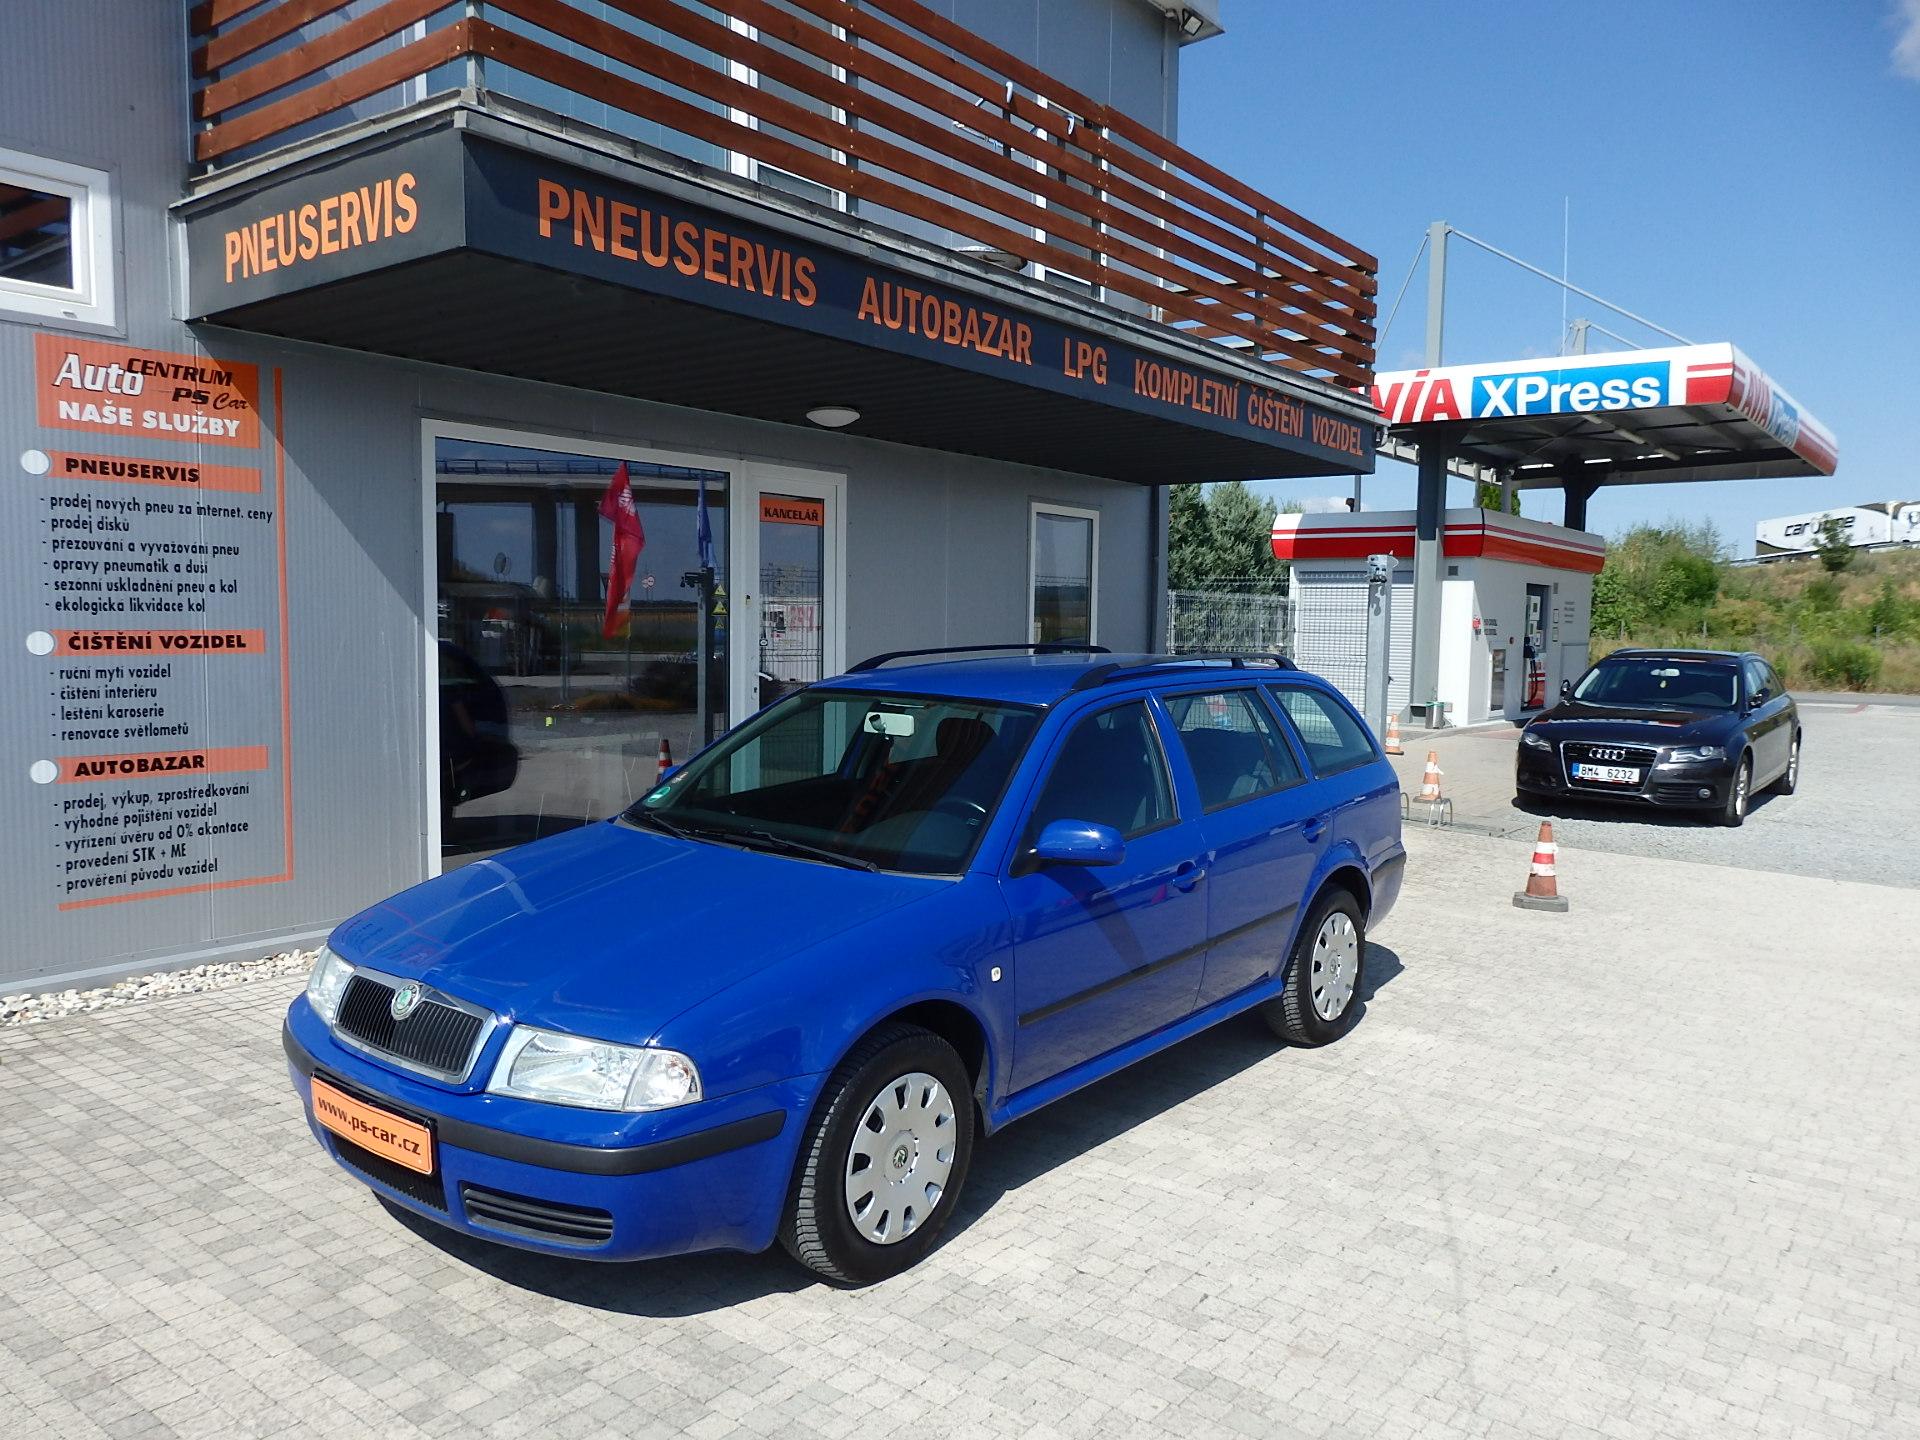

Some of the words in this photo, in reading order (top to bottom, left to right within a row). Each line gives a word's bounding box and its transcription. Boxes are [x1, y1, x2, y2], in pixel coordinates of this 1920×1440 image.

[225, 173, 418, 283] PNEUSERVIS
[538, 178, 817, 307] PNEUSERVIS
[858, 276, 1032, 367] AUTOBAZAR
[1064, 337, 1108, 385] LPG
[1134, 358, 1241, 420] KOMPLETNÍ
[1247, 385, 1305, 438] ČIŠTĚNÍ
[1312, 413, 1363, 456] VOZIDEL
[52, 352, 145, 396] Auto
[127, 358, 233, 386] CENTRUM
[172, 387, 211, 405] PS
[212, 392, 249, 410] Car
[1479, 375, 1663, 419] XPress
[58, 399, 133, 427] NAŠE
[142, 409, 240, 438] SLUŽBY
[65, 457, 200, 483] PNEUSERVIS
[50, 493, 91, 512] prodej
[96, 497, 141, 514] nových
[146, 502, 174, 515] pneu
[178, 504, 192, 515] za
[197, 501, 244, 518] internet.
[247, 510, 273, 523] ceny
[764, 507, 818, 521] KANCELÁŘ
[52, 514, 92, 534] prodej
[128, 542, 135, 552] a
[212, 545, 240, 558] pneu
[53, 560, 99, 574] opravy
[104, 558, 169, 575] pneumatik
[174, 563, 181, 573] a
[177, 582, 205, 596] pneu
[209, 584, 216, 593] a
[220, 579, 237, 593] kol
[130, 597, 183, 612] likvidace
[188, 598, 205, 612] kol
[68, 632, 152, 650] ČIŠTĚNÍ
[159, 634, 246, 650] VOZIDEL
[129, 663, 171, 678] vozidel
[107, 703, 164, 719] karoserie
[62, 729, 119, 741] renovace
[74, 754, 205, 777] AUTOBAZAR
[1607, 769, 1634, 779] 6232
[177, 802, 217, 818] vozidel
[159, 825, 172, 840] od
[177, 823, 193, 838] 0%
[198, 822, 249, 836] akontace
[133, 847, 156, 862] STK
[171, 843, 186, 858] ME
[178, 858, 218, 875] vozidel
[317, 1096, 421, 1155] www.ps-car.cz
